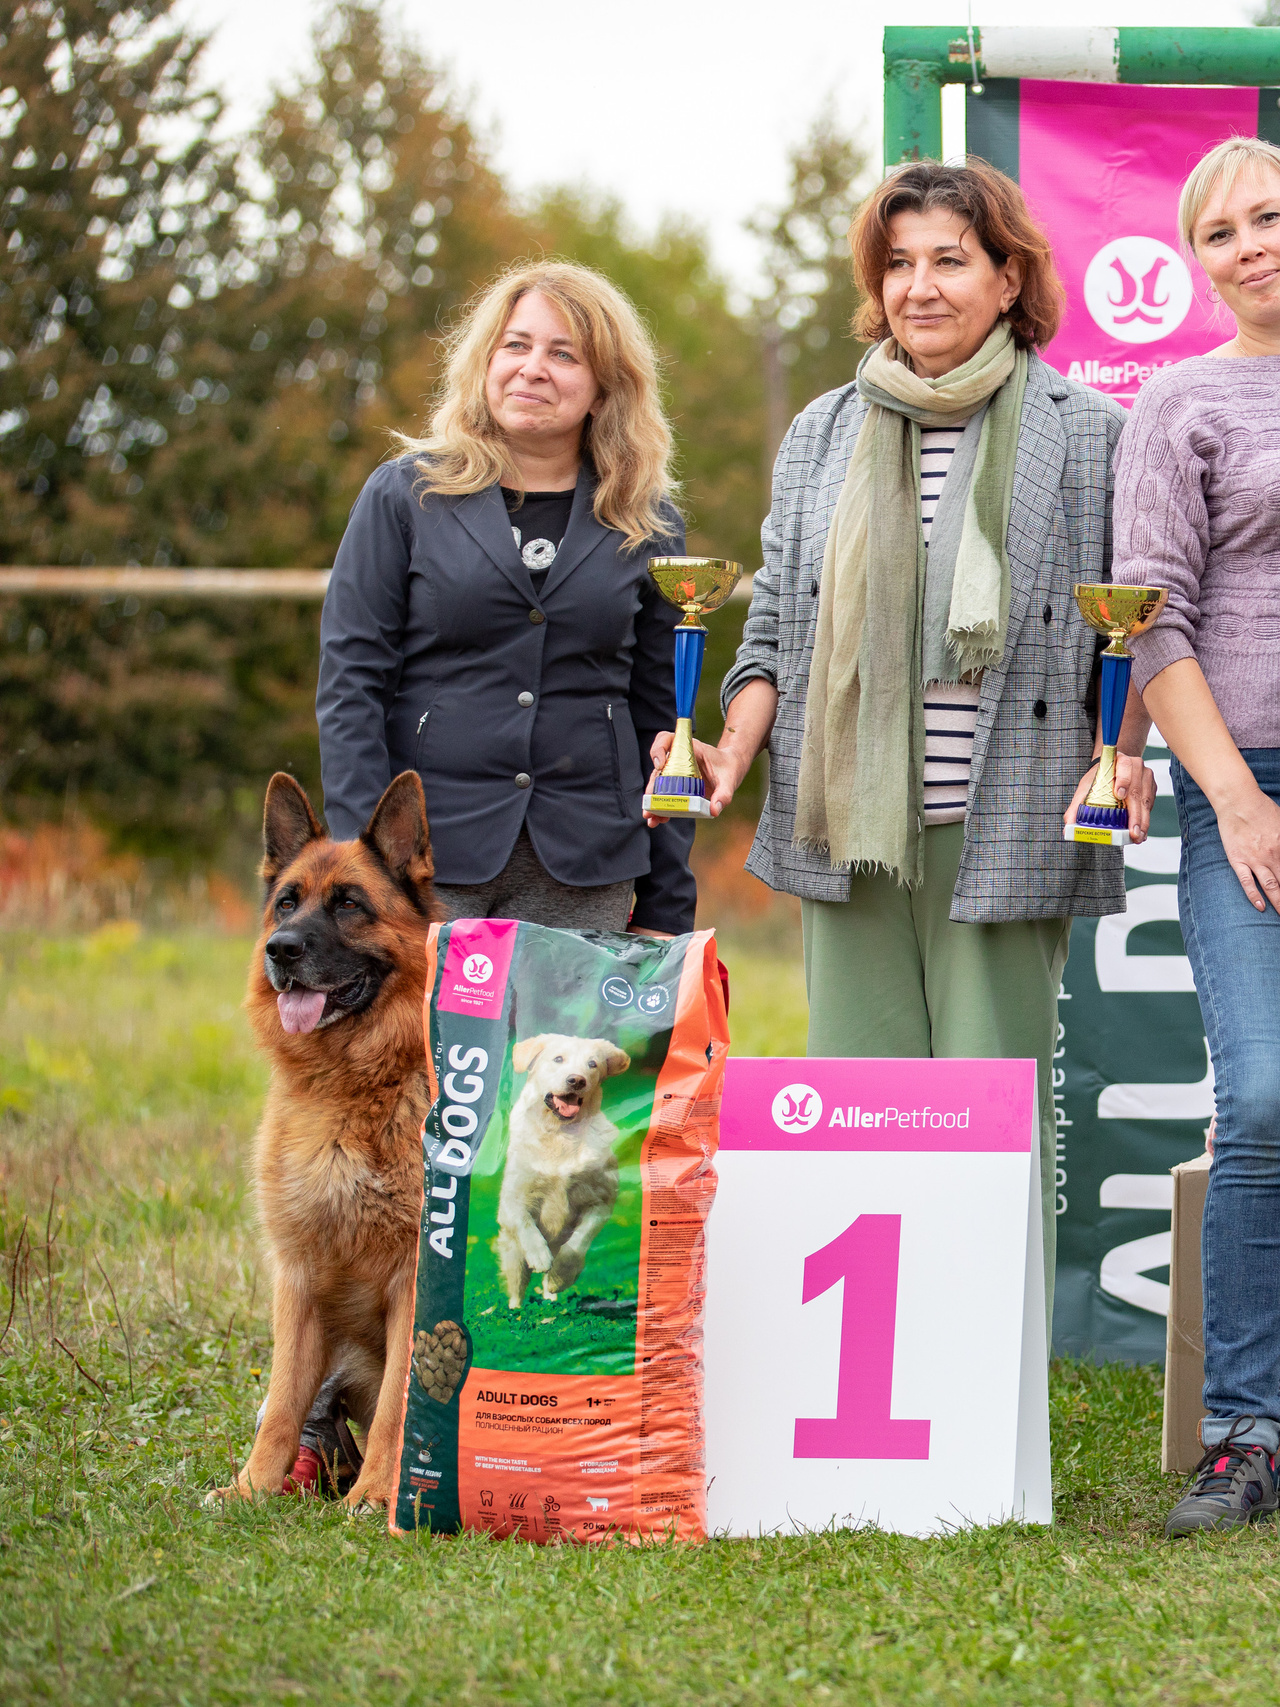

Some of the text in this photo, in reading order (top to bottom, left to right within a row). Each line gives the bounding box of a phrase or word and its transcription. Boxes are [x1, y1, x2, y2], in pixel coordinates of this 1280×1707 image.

[453, 984, 495, 998] AllerPetfood
[434, 1041, 443, 1059] for
[828, 1106, 970, 1129] AllerPetfood
[429, 1044, 489, 1259] ALL DOGS
[793, 1213, 932, 1460] 1
[477, 1390, 558, 1407] ADULT DOGS
[586, 1397, 602, 1408] 1+
[476, 1411, 492, 1419] ДЛЯ
[492, 1413, 534, 1423] ВЗРОСЛЫХ
[535, 1416, 562, 1425] СОБАК
[584, 1418, 612, 1426] ПОРОД
[475, 1421, 563, 1434] ПОЛНОЦЕННЫЙ РАЦИОН
[583, 1522, 594, 1530] 20
